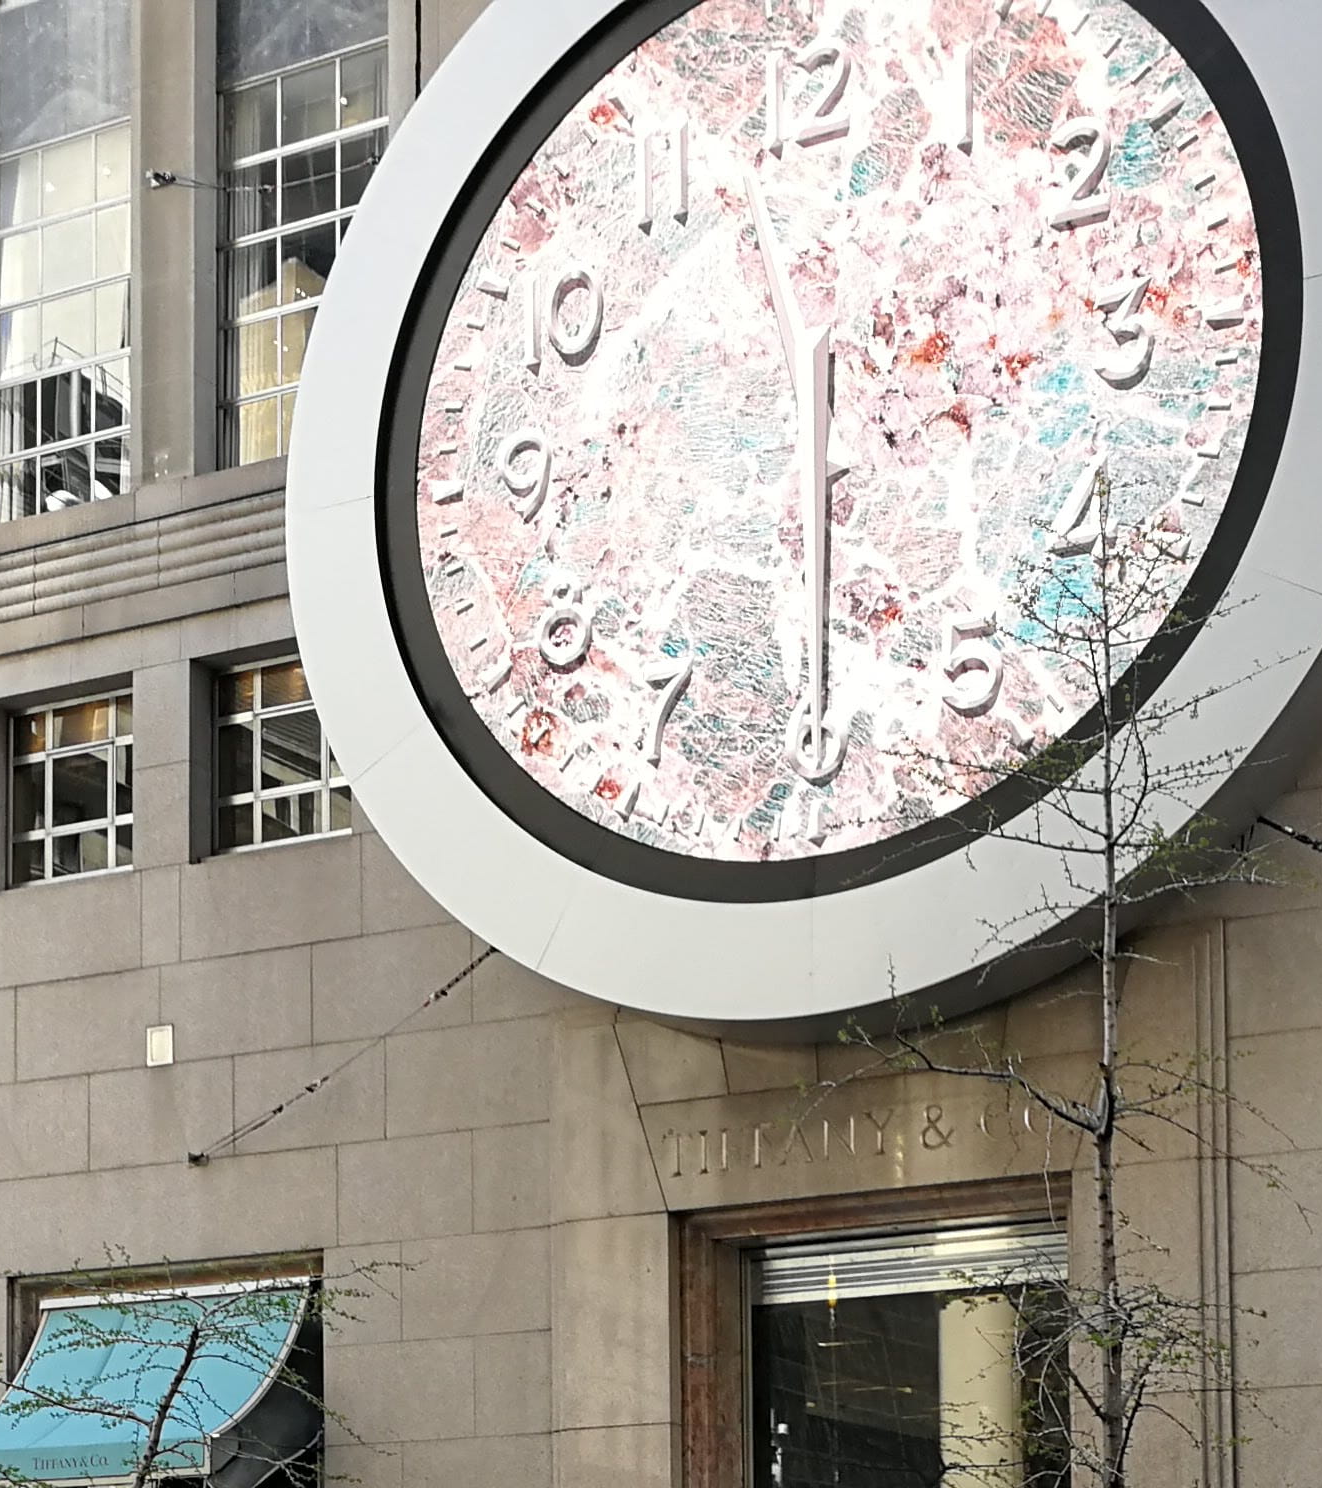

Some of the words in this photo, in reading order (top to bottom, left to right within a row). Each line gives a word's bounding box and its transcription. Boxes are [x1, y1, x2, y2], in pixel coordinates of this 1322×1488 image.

[765, 46, 852, 160] 12
[632, 112, 690, 237] 11
[1050, 115, 1113, 233] 2
[523, 268, 605, 378] 10
[1093, 277, 1157, 391] 3
[499, 428, 552, 524] 9
[1049, 450, 1125, 560] 4
[537, 575, 593, 675] 8
[939, 610, 1009, 719] 5
[643, 652, 695, 768] 7
[785, 683, 850, 790] 6
[661, 1106, 895, 1179] TIFFANY
[919, 1104, 955, 1151] &
